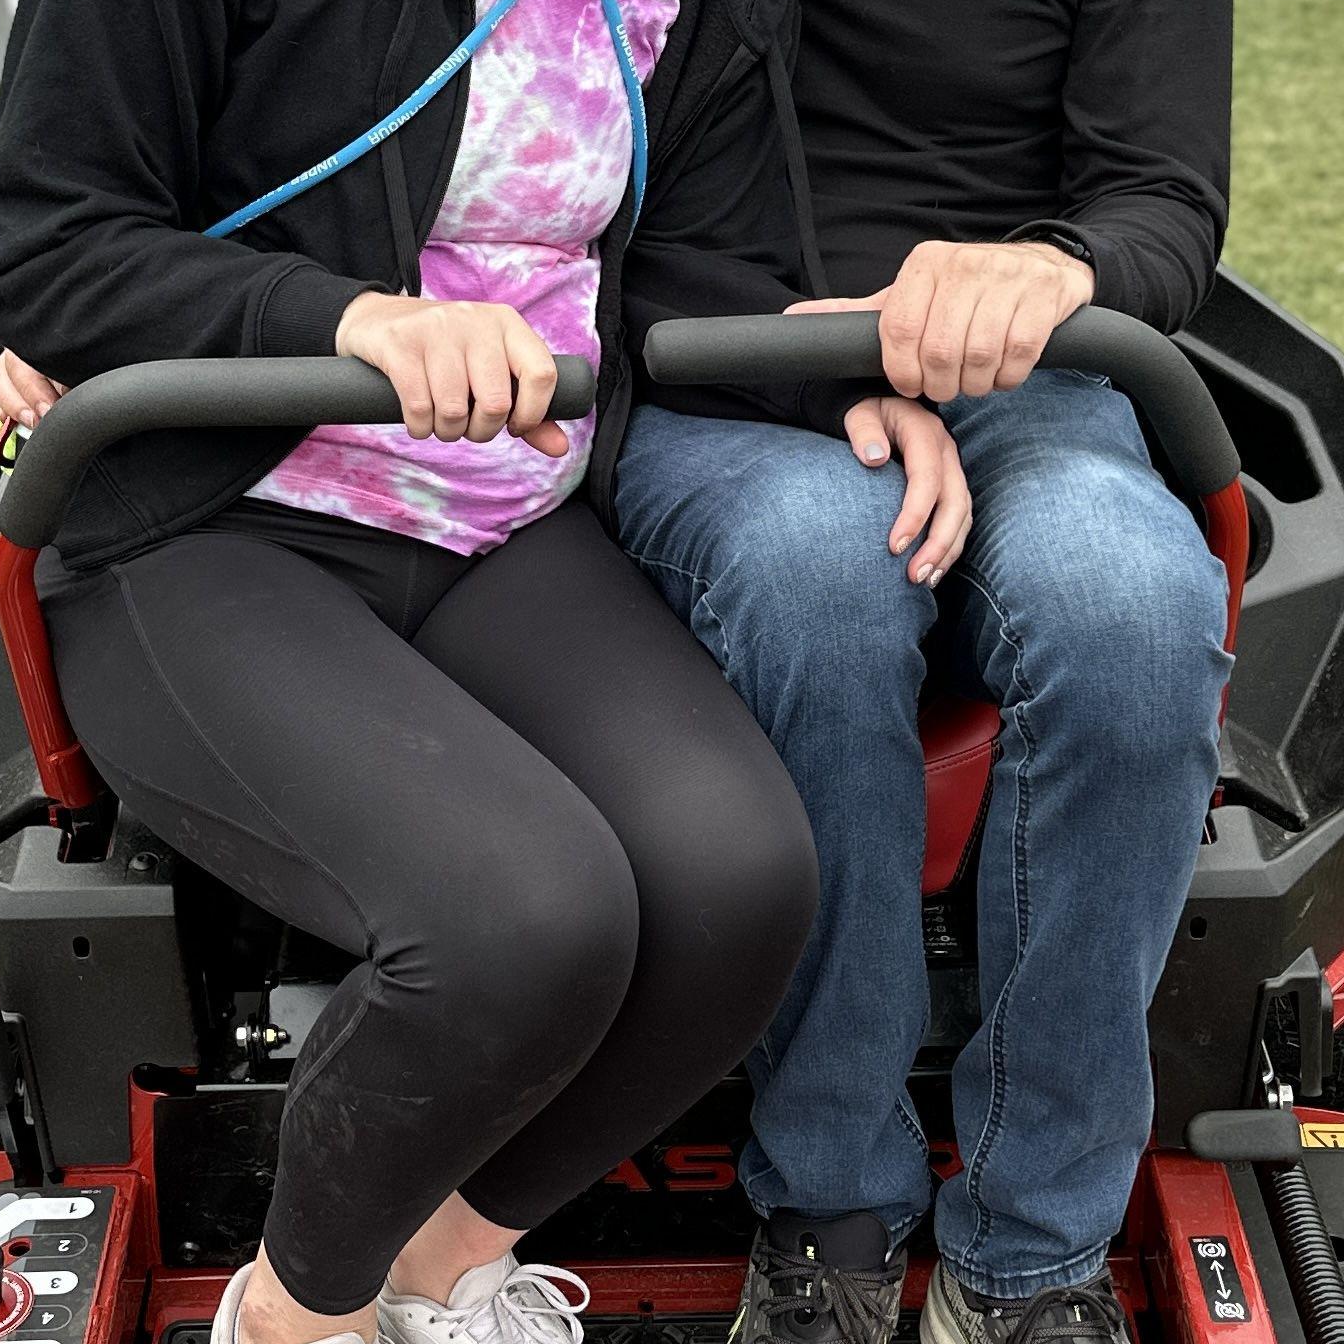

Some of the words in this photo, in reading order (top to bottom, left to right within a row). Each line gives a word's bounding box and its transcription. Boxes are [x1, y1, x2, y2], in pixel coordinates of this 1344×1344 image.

[425, 47, 470, 86] UNDER
[68, 1202, 77, 1214] 1
[57, 1239, 71, 1252] 2
[50, 1277, 62, 1289] 3
[41, 1312, 55, 1325] 4
